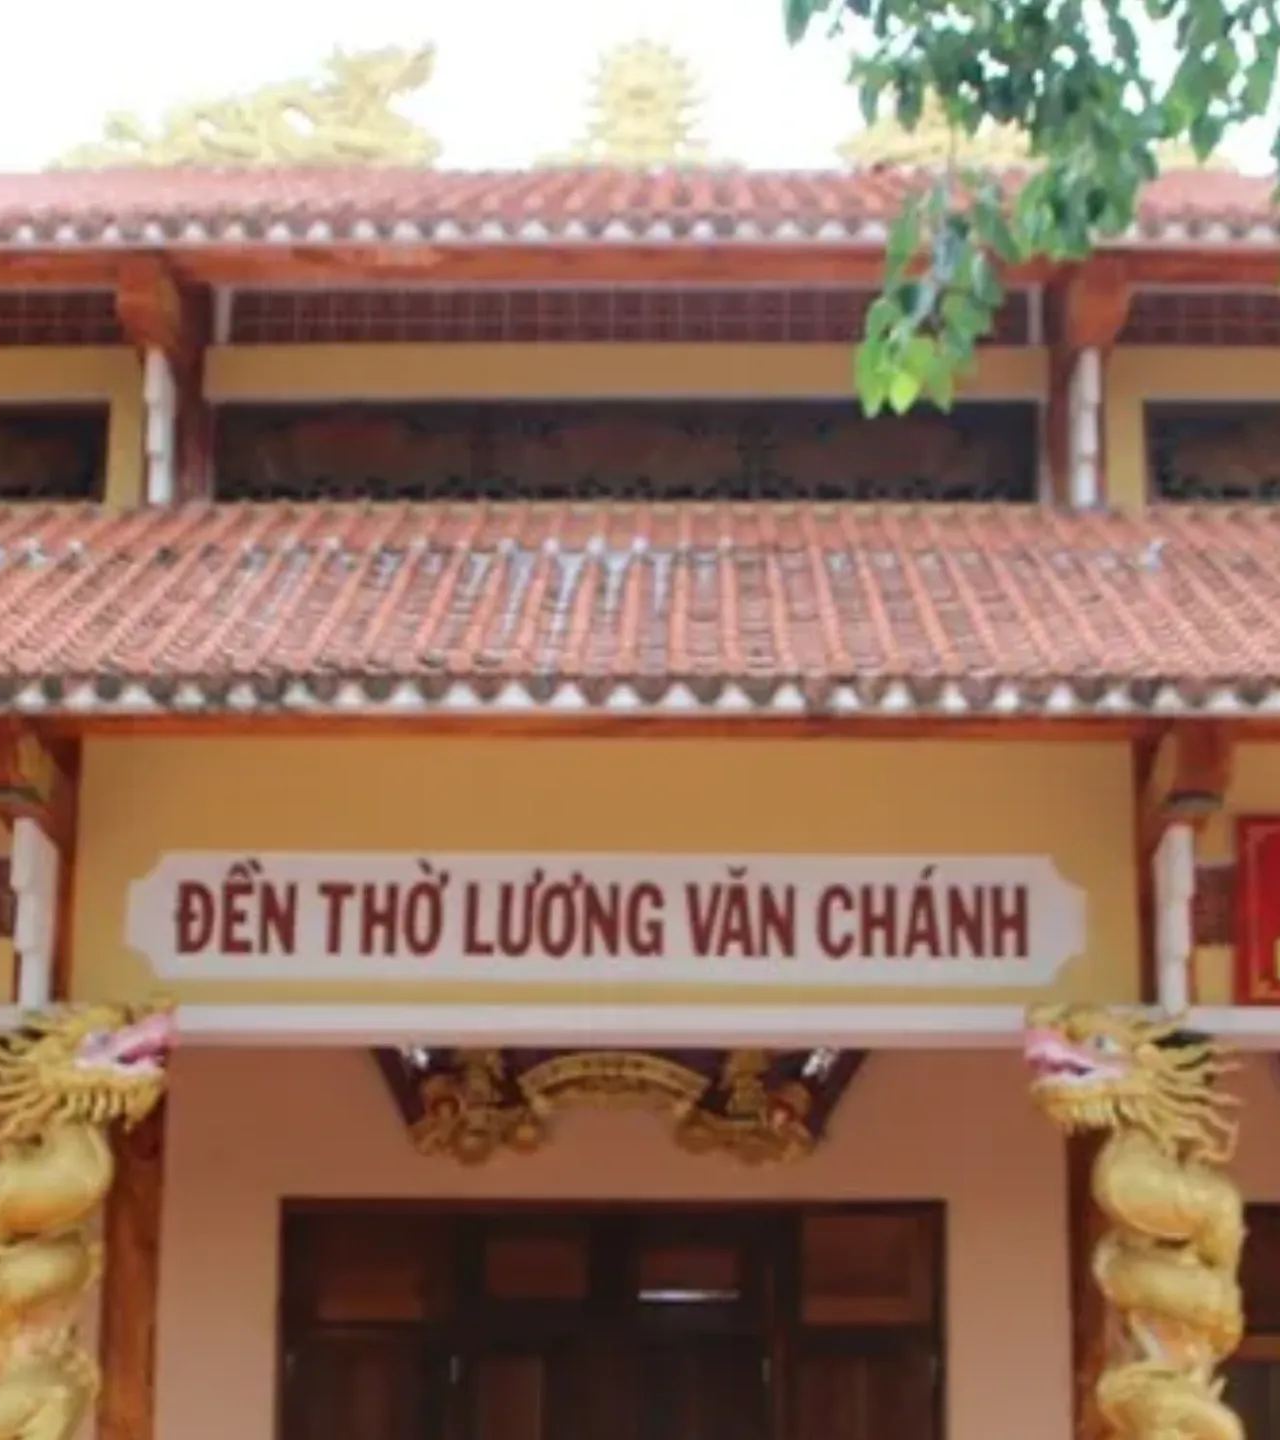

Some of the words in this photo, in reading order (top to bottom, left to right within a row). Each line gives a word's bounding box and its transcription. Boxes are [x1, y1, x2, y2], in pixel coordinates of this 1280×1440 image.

[175, 859, 297, 956] ĐỀN
[318, 860, 450, 957] THỜ
[463, 868, 665, 958] LƯƠNG
[685, 865, 796, 958] VĂN
[816, 865, 1028, 959] CHÁNH
